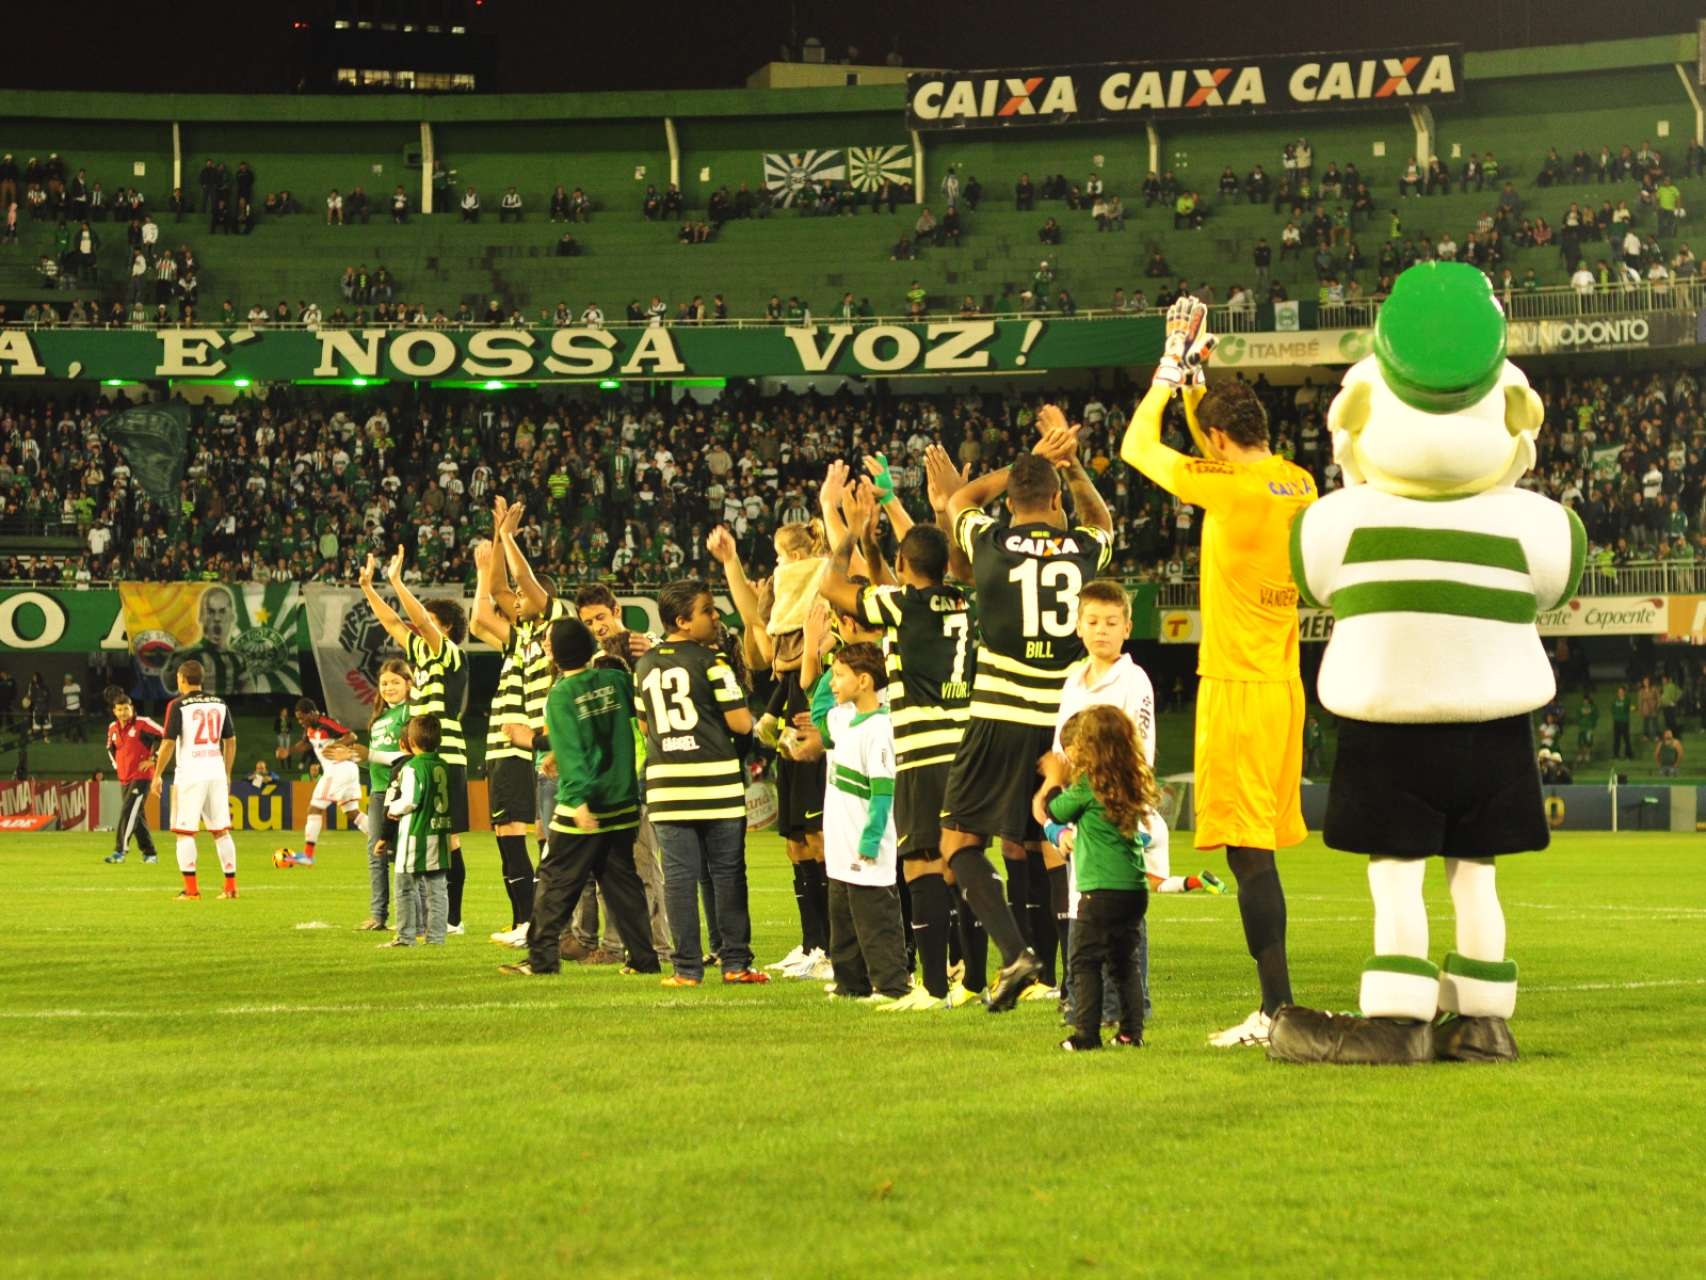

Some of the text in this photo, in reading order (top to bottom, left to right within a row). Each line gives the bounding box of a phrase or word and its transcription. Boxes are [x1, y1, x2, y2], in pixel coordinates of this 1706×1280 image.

[913, 54, 1456, 119] CAIXA CAIXA CAIXA
[313, 326, 685, 377] NOSSA
[1249, 338, 1320, 359] ITAMBÉ
[1524, 318, 1649, 347] UNIODONTO
[1005, 535, 1079, 557] CAIXA
[1009, 558, 1082, 637] 13
[1584, 608, 1656, 630] Expoente
[943, 613, 968, 682] 7
[1026, 641, 1054, 659] BILL
[642, 666, 699, 734] 13
[192, 708, 221, 745] 20
[432, 765, 449, 814] 3
